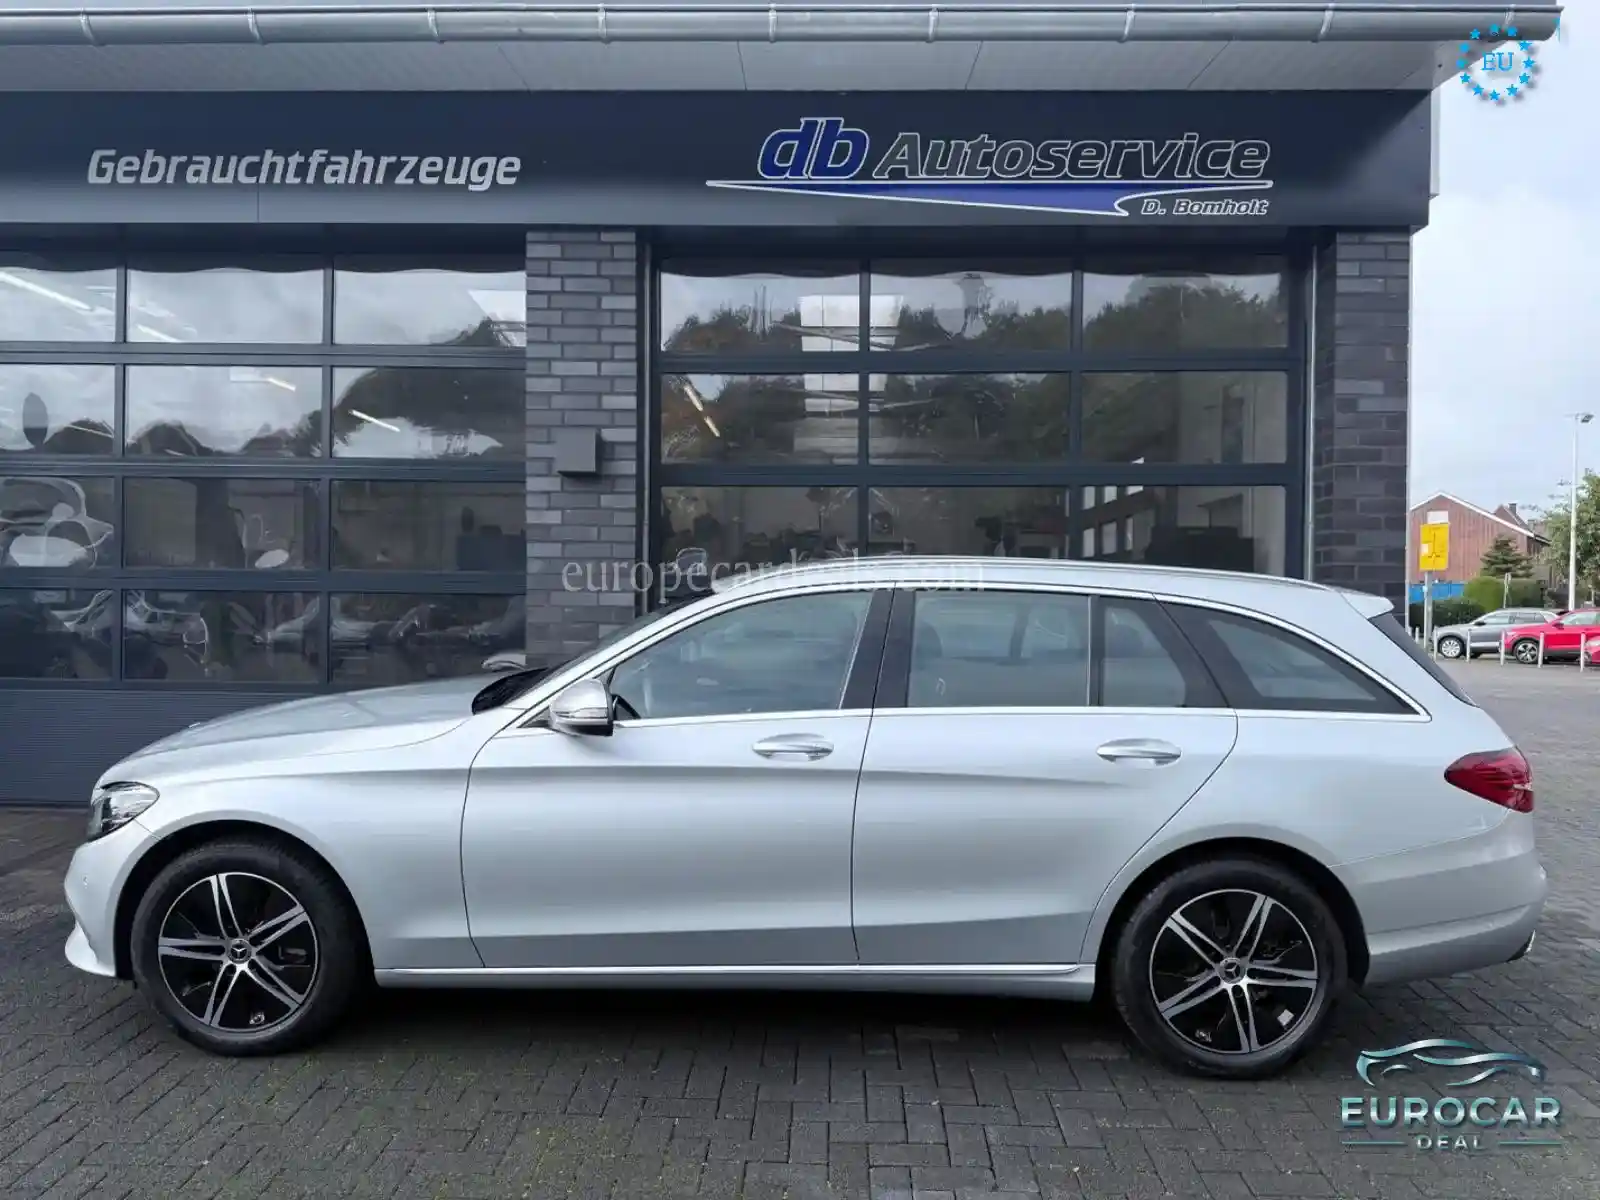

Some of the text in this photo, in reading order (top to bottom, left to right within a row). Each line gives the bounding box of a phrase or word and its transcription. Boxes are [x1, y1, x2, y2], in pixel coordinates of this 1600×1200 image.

[758, 117, 1272, 178] db Autoservice
[87, 149, 522, 192] Gebrauchtfahrzeuge
[1141, 198, 1269, 215] D. Bomholt
